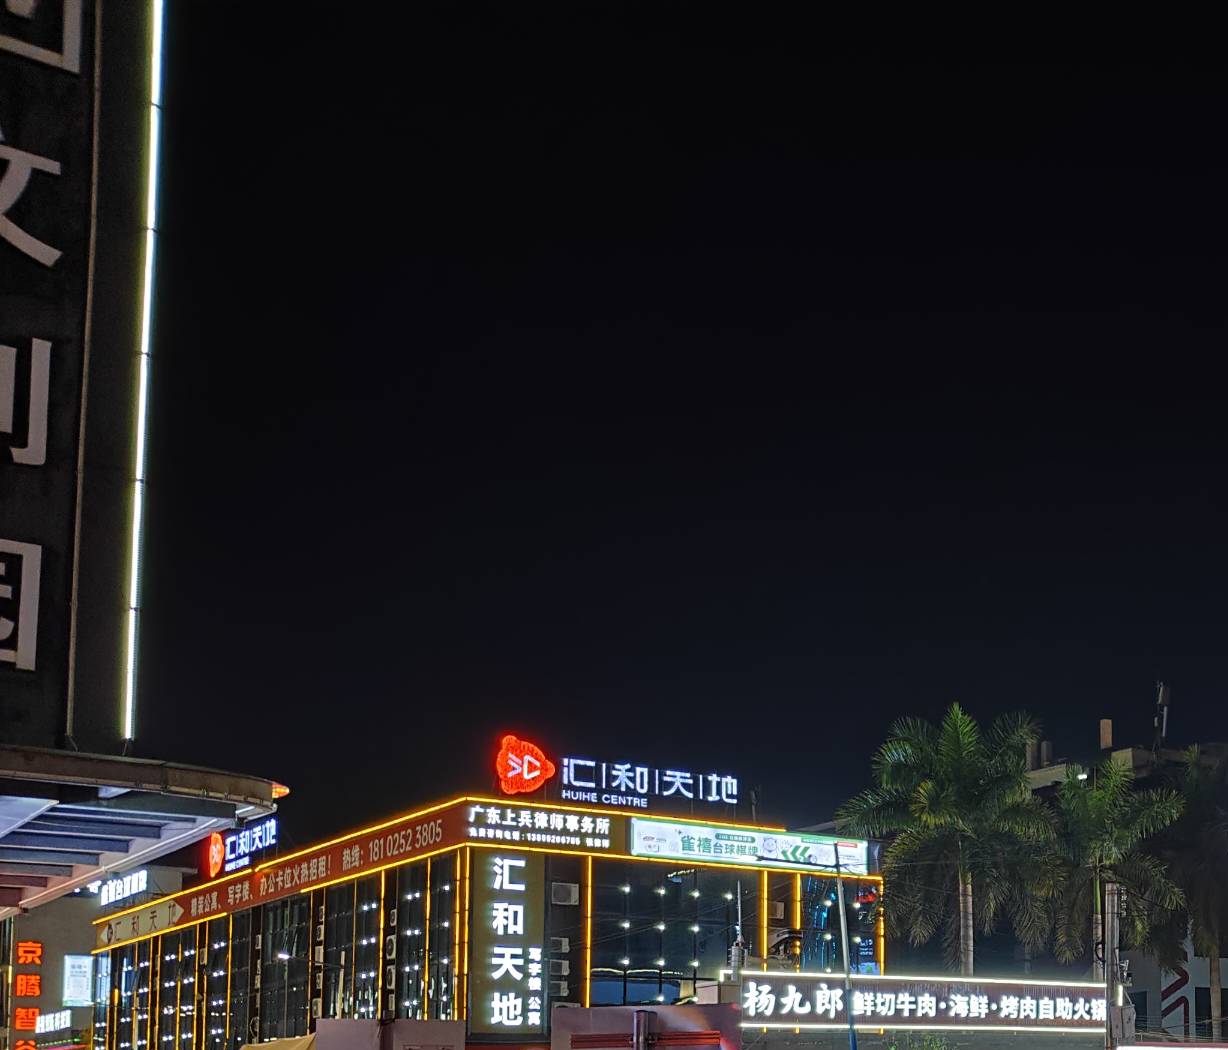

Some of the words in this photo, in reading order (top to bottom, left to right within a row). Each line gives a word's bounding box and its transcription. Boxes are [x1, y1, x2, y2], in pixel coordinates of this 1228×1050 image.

[562, 757, 738, 804] 汇和天地
[562, 790, 598, 804] HUIHE
[602, 794, 648, 808] CENTRE
[386, 831, 413, 858] 0252
[415, 819, 444, 850] 3805
[490, 857, 527, 1026] 汇和天地
[743, 982, 844, 1018] 杨九郎
